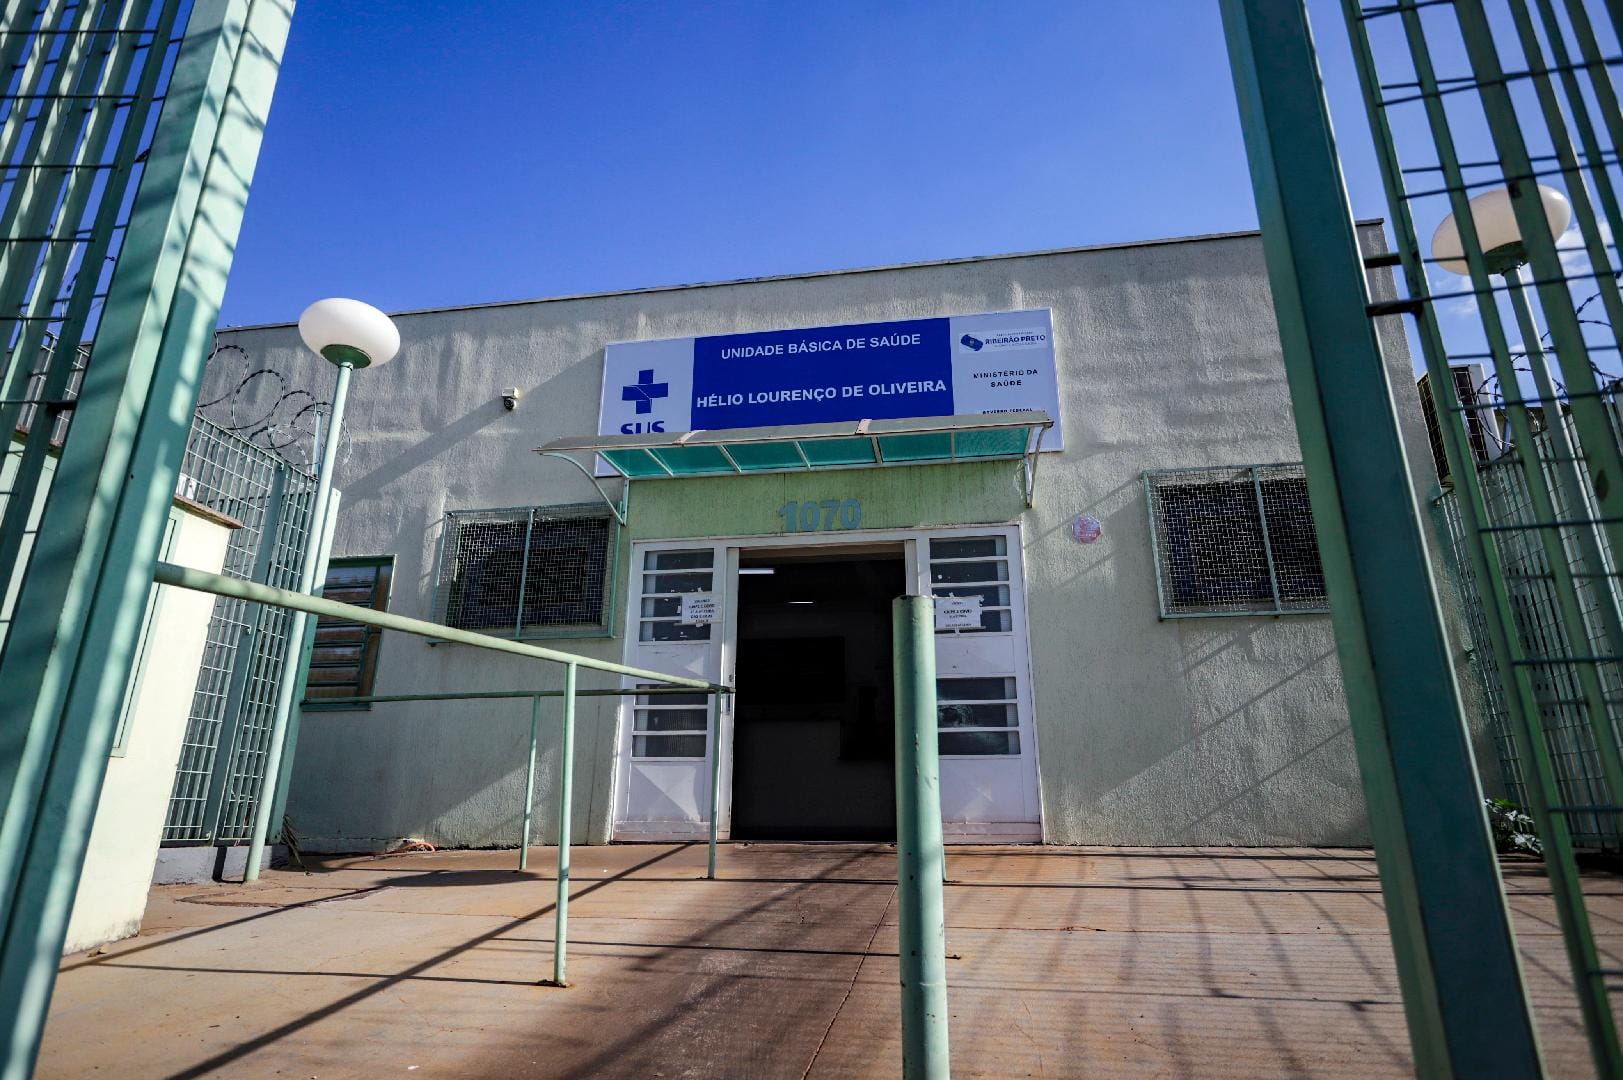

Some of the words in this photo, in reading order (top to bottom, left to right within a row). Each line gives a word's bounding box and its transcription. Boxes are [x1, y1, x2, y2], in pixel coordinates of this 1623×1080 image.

[721, 344, 784, 360] UNIDADE
[788, 340, 843, 354] BÁSICA
[846, 337, 866, 350] DE
[869, 333, 921, 348] SAÚDE
[1020, 334, 1046, 343] PRETO
[696, 391, 744, 408] HÉLIO
[748, 387, 837, 404] LOURENÇO
[842, 385, 864, 398] DE
[868, 379, 947, 396] OLIVEIRA
[990, 380, 1022, 388] SAÚDE
[777, 498, 862, 532] 1070
